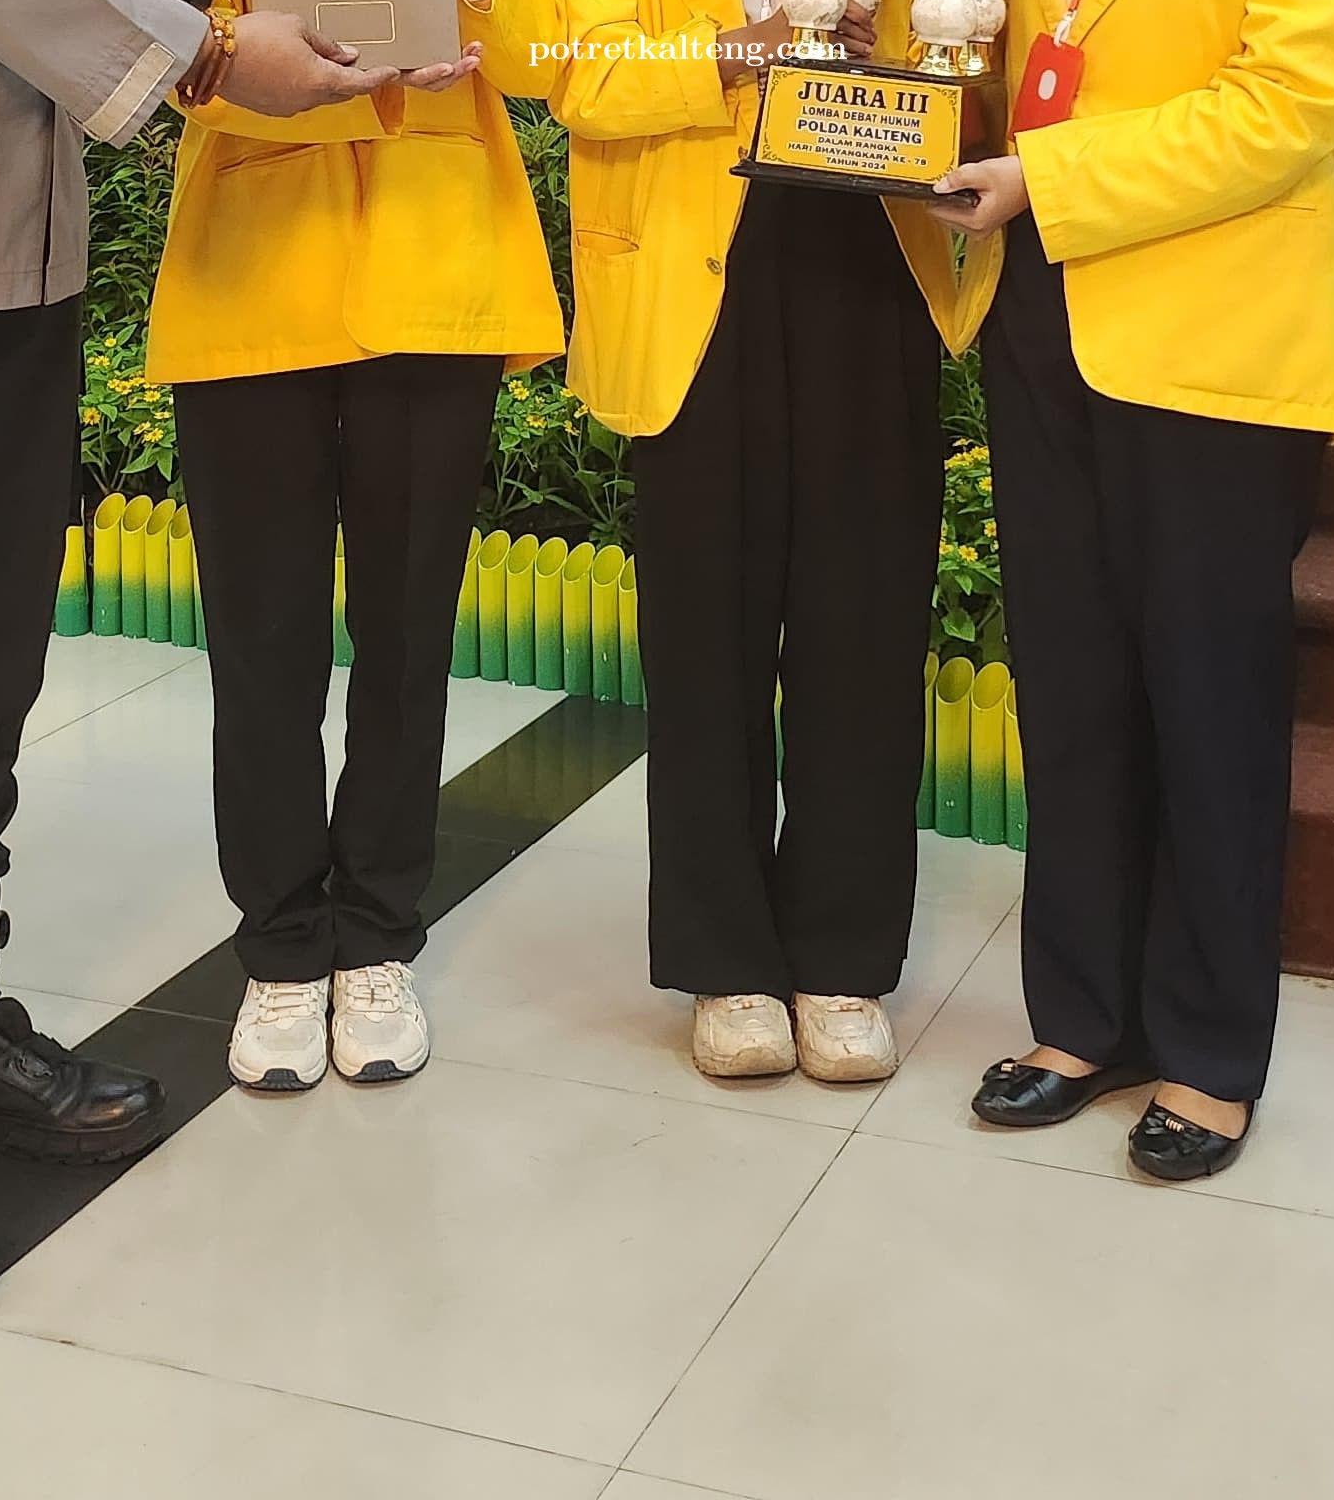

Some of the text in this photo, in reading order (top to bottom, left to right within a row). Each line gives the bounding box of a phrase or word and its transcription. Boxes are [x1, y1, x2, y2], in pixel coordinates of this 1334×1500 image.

[797, 80, 929, 114] JUARA III
[802, 105, 920, 128] LOMBA DEBAT HUKUM
[797, 119, 922, 145] POLDA KALTENG
[787, 143, 813, 152] HARI
[815, 145, 890, 162] BHAYANGKARA
[892, 155, 906, 164] KE
[818, 136, 898, 153] DALAM RANGKA
[826, 156, 887, 170] TAHUN 2024
